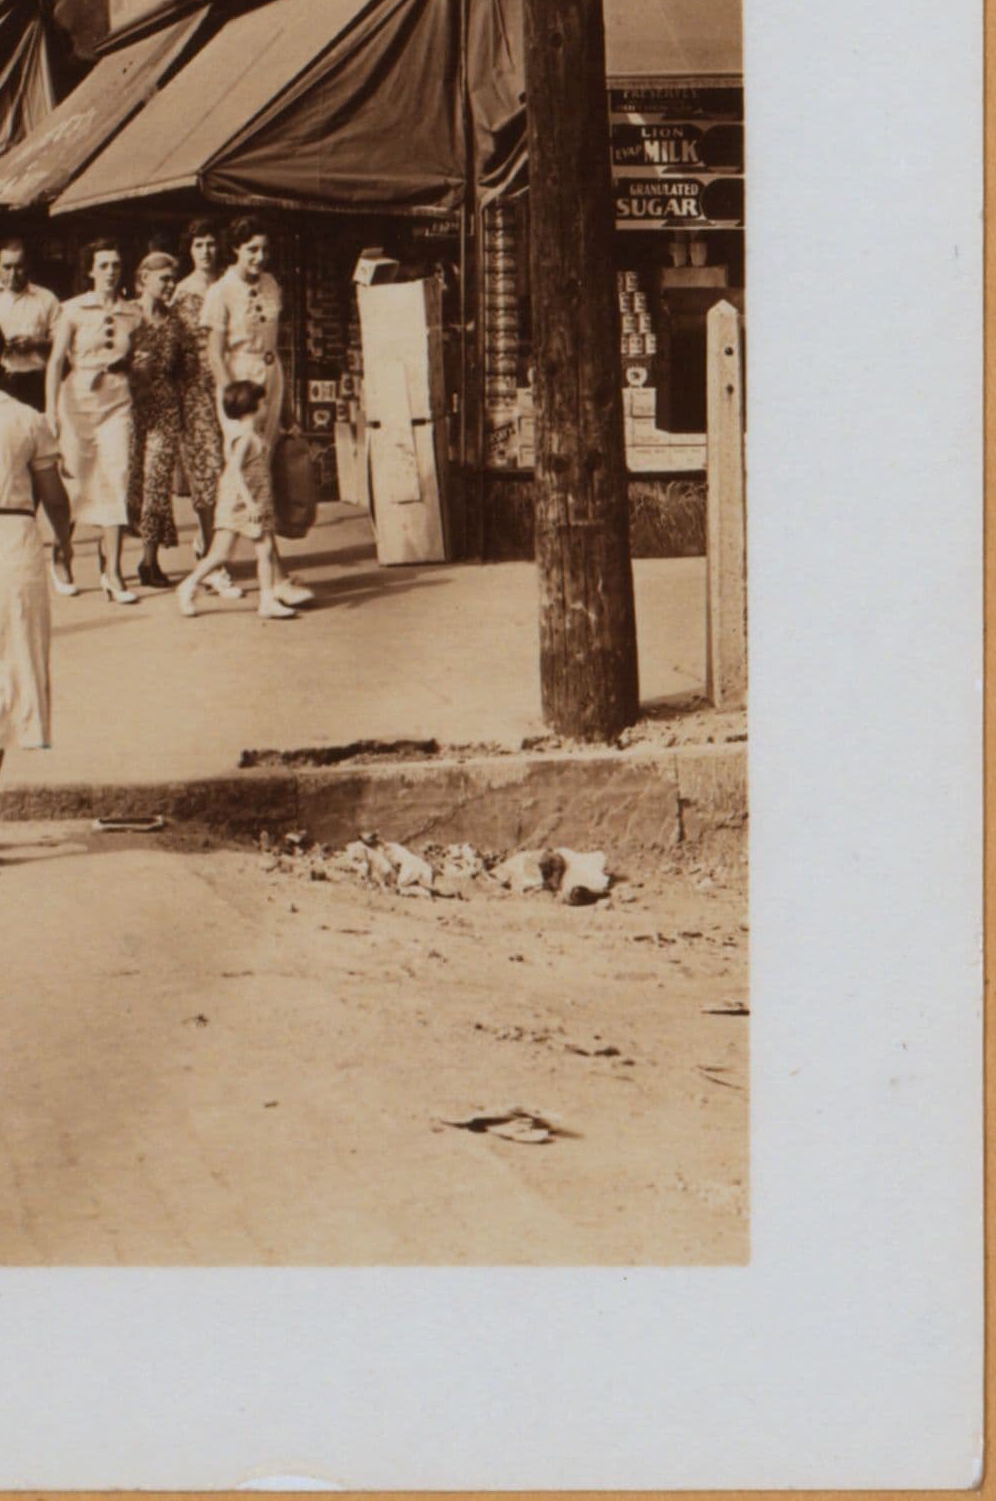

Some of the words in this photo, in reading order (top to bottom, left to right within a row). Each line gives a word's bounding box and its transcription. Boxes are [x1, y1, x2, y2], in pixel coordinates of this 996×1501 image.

[640, 127, 684, 138] LION
[644, 140, 698, 162] MILK
[629, 182, 699, 196] GRANULATED
[615, 198, 699, 217] SUGAR
